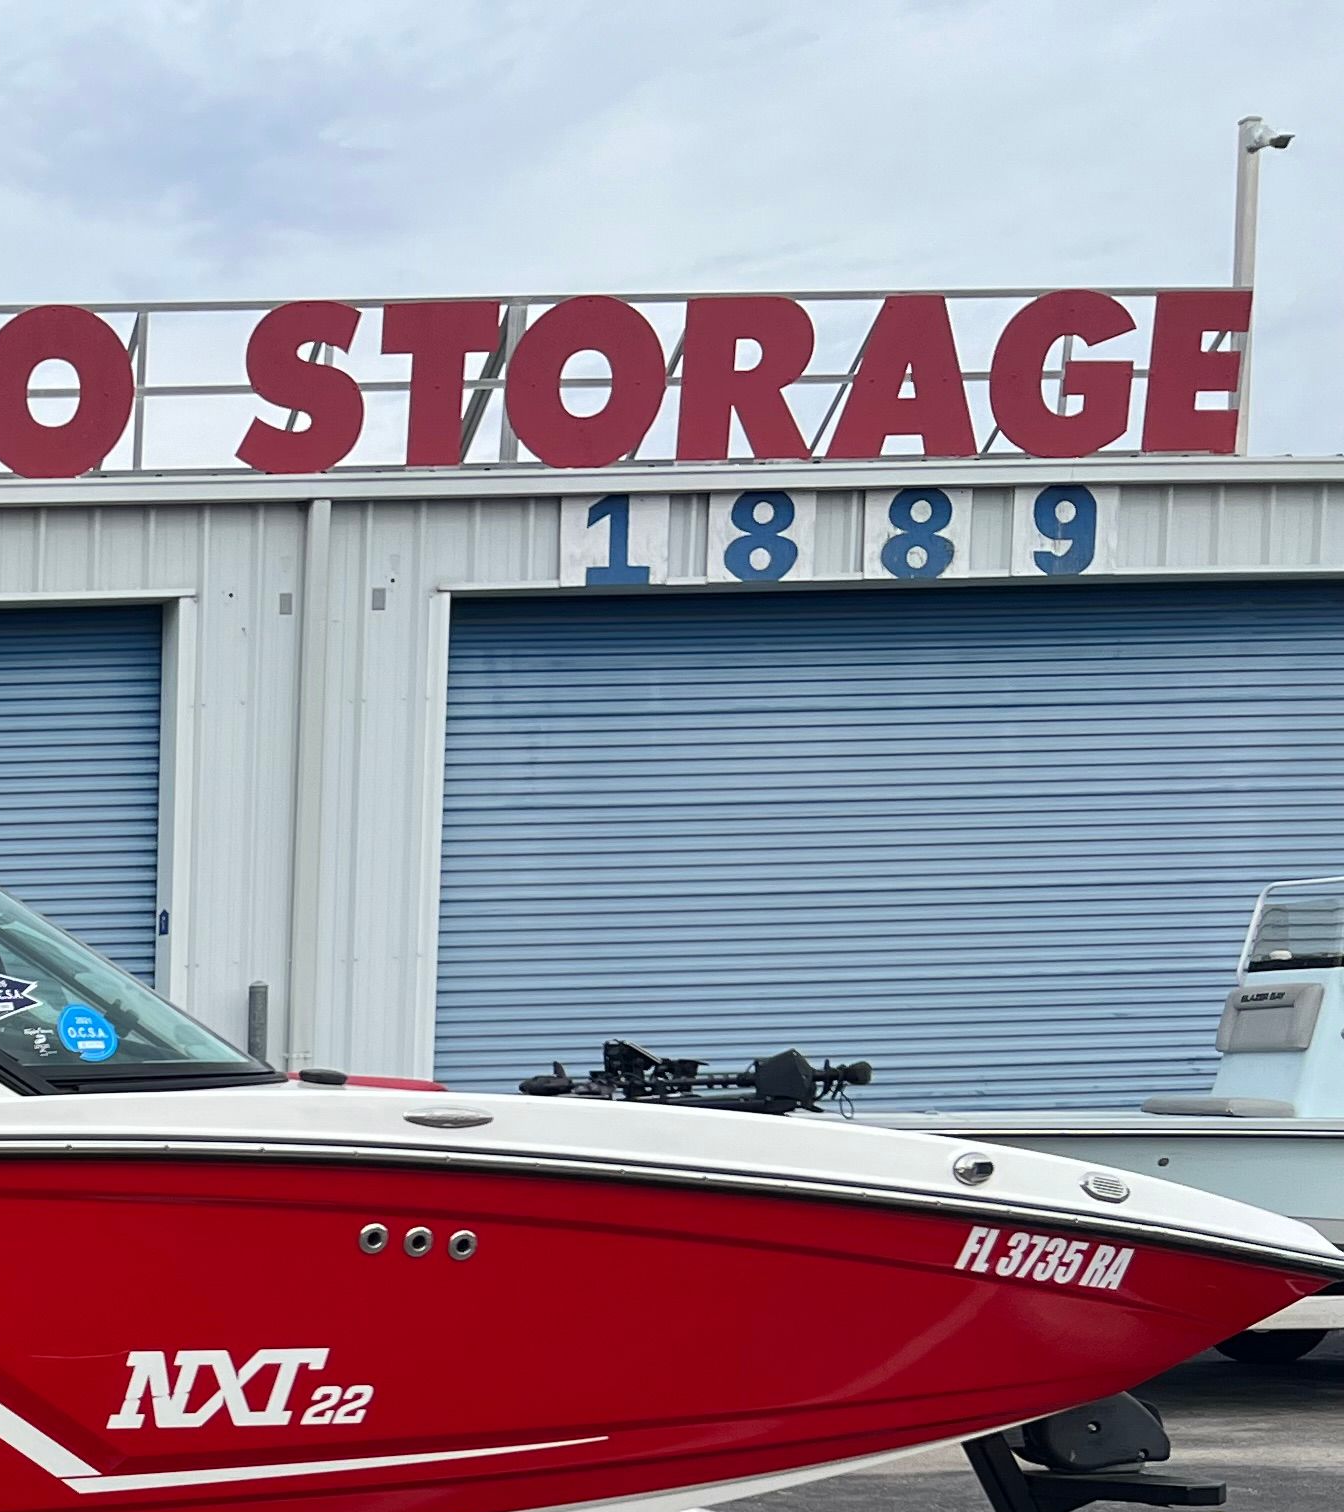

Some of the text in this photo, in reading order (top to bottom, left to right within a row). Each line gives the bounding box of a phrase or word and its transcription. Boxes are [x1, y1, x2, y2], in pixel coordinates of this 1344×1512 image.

[236, 290, 1252, 475] STORAGE
[585, 484, 1098, 587] 1889
[954, 1225, 1135, 1290] FL 3735 RA
[106, 1347, 374, 1430] NXT 22
